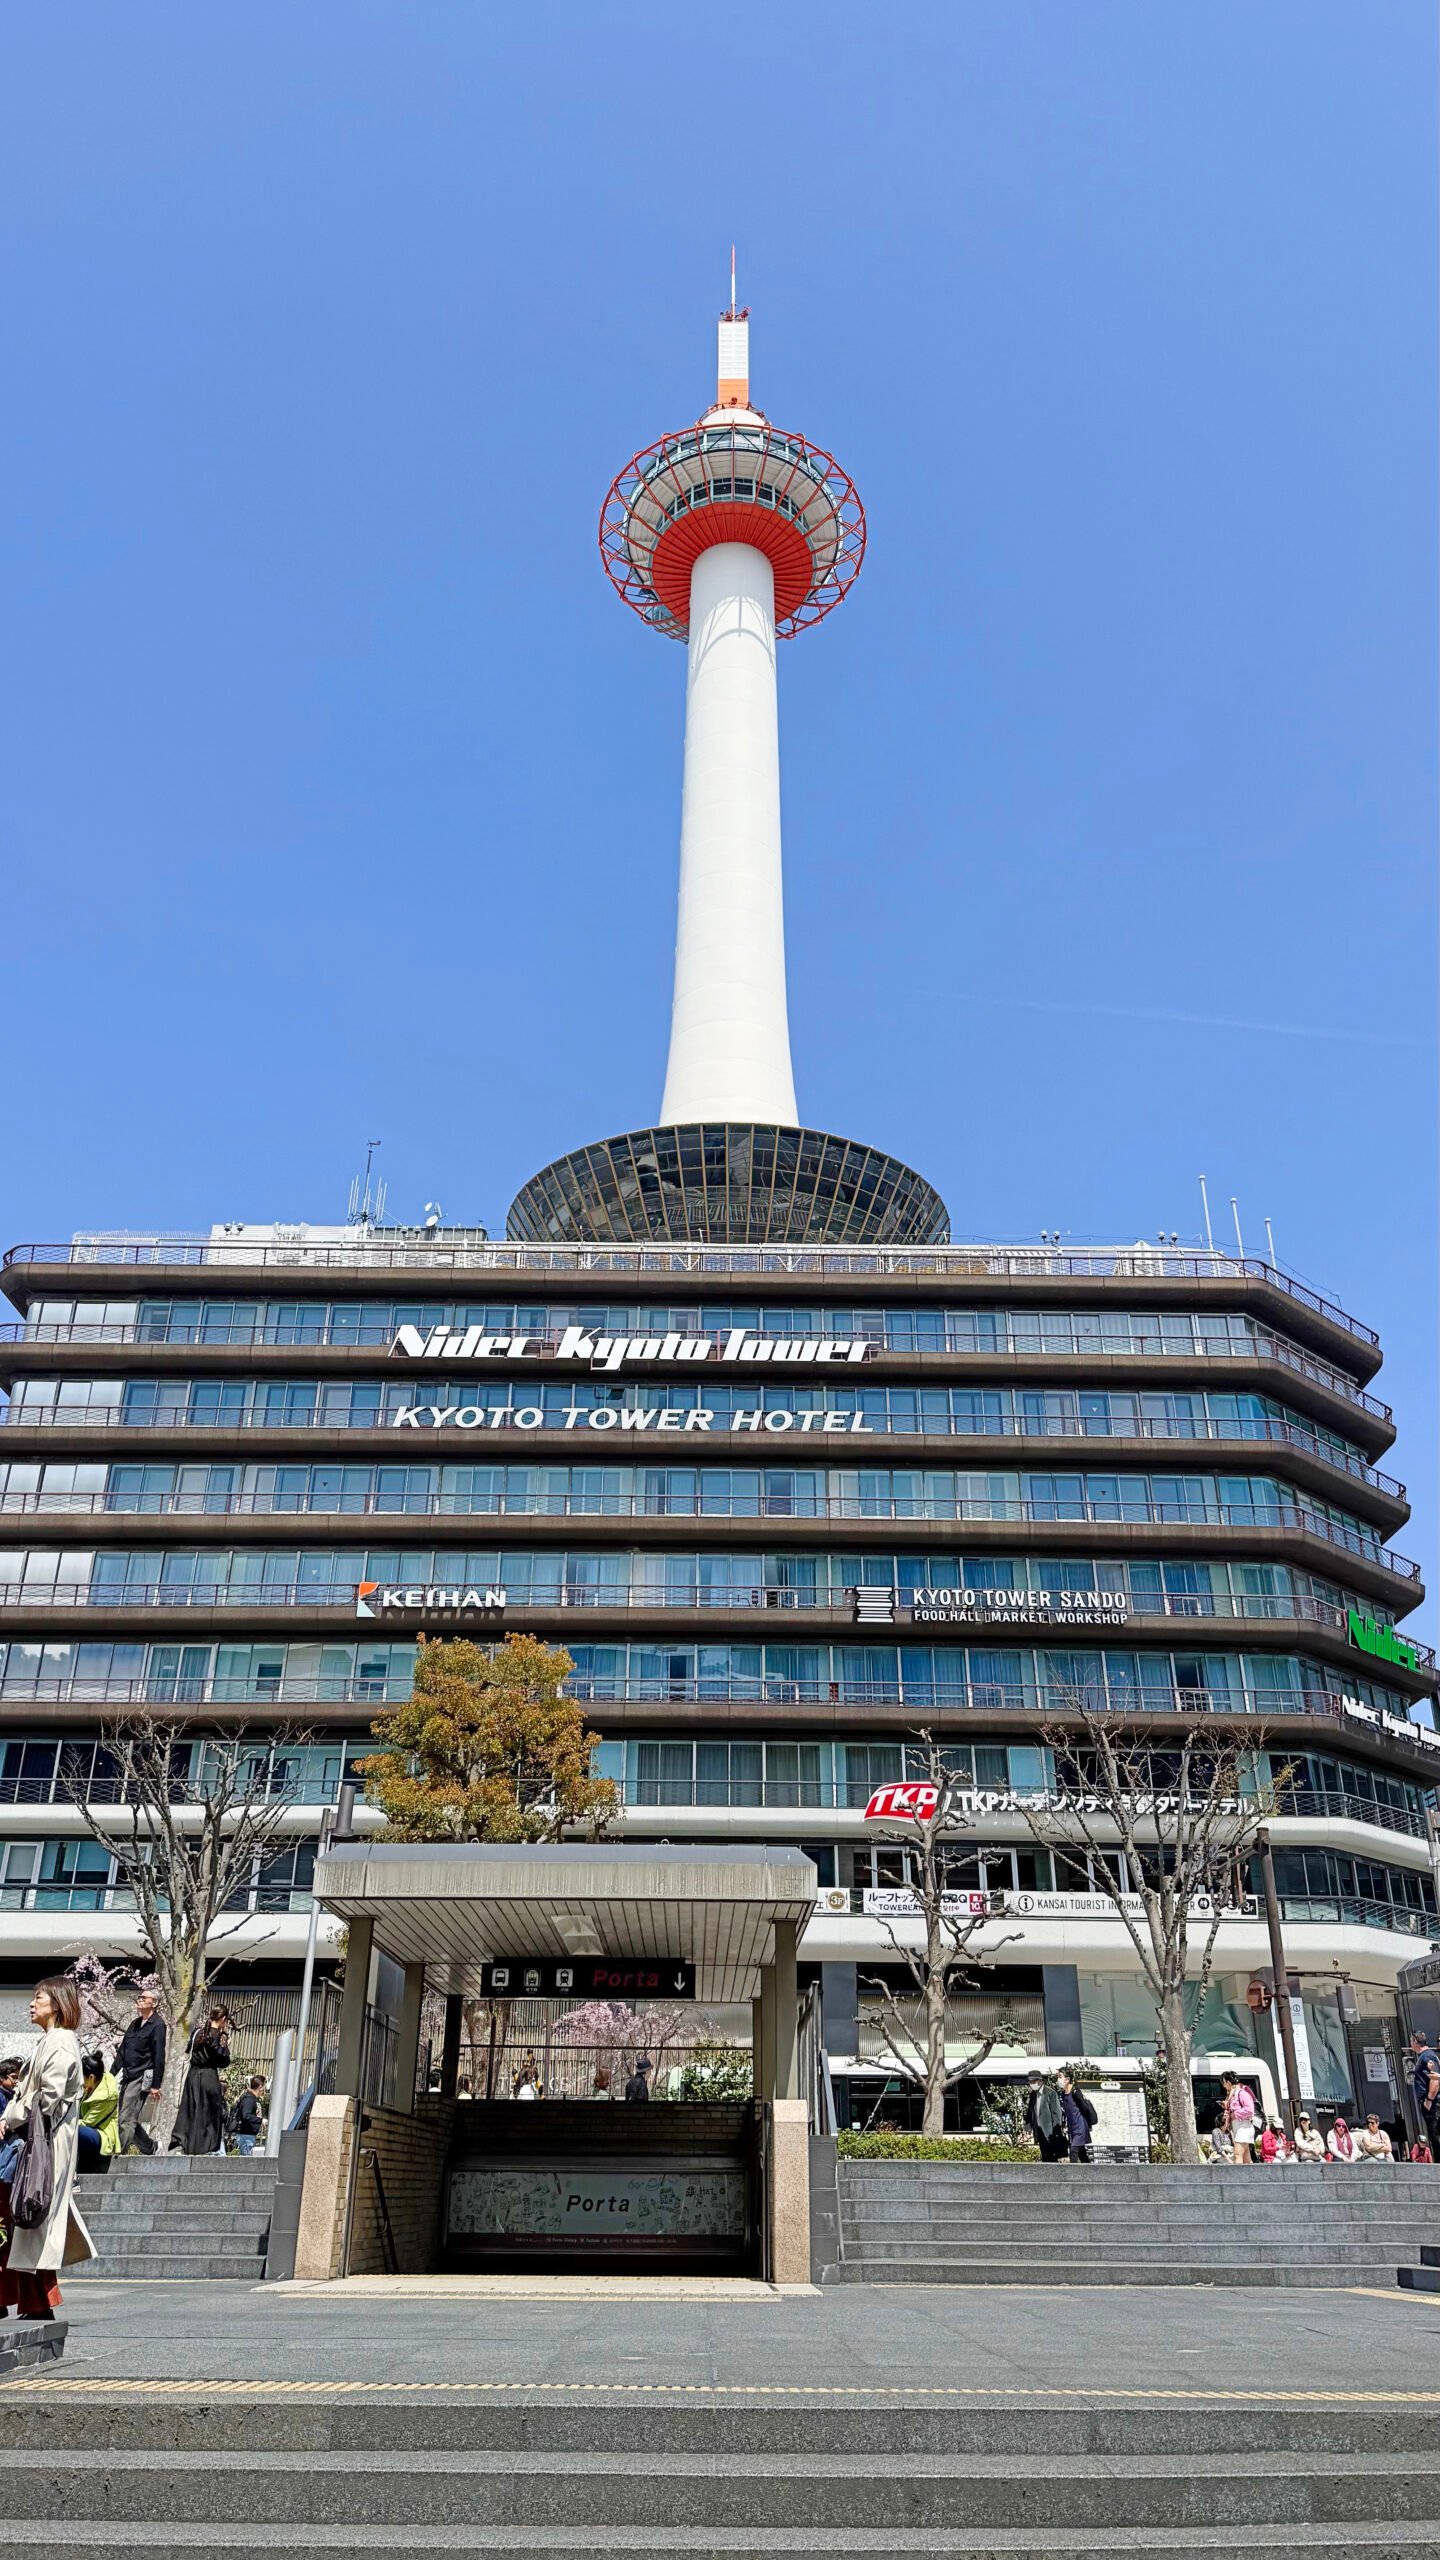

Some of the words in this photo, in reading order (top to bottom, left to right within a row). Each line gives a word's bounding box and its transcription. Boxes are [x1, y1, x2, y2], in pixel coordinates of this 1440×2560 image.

[388, 1324, 545, 1359] Nidec
[555, 1326, 713, 1371] Kyoto
[722, 1328, 879, 1363] Tower
[393, 1405, 543, 1430] KYOTO
[561, 1407, 714, 1432] TOWER
[730, 1409, 874, 1433] HOTEL
[382, 1588, 507, 1608] KEIHAN
[913, 1588, 976, 1608] KYOTO
[983, 1589, 1051, 1608] TOWER
[1060, 1591, 1127, 1609] SANDO
[914, 1610, 946, 1622] FOOD
[949, 1610, 982, 1623] HALL
[991, 1611, 1045, 1624] MARKET
[1055, 1612, 1128, 1625] WORKSHOP
[870, 1787, 939, 1813] TKP
[830, 1895, 844, 1905] 3F
[1037, 1899, 1067, 1909] KANSAI
[1070, 1899, 1106, 1910] TOURIST
[591, 1969, 660, 1988] Porta
[565, 2194, 631, 2213] Porta
